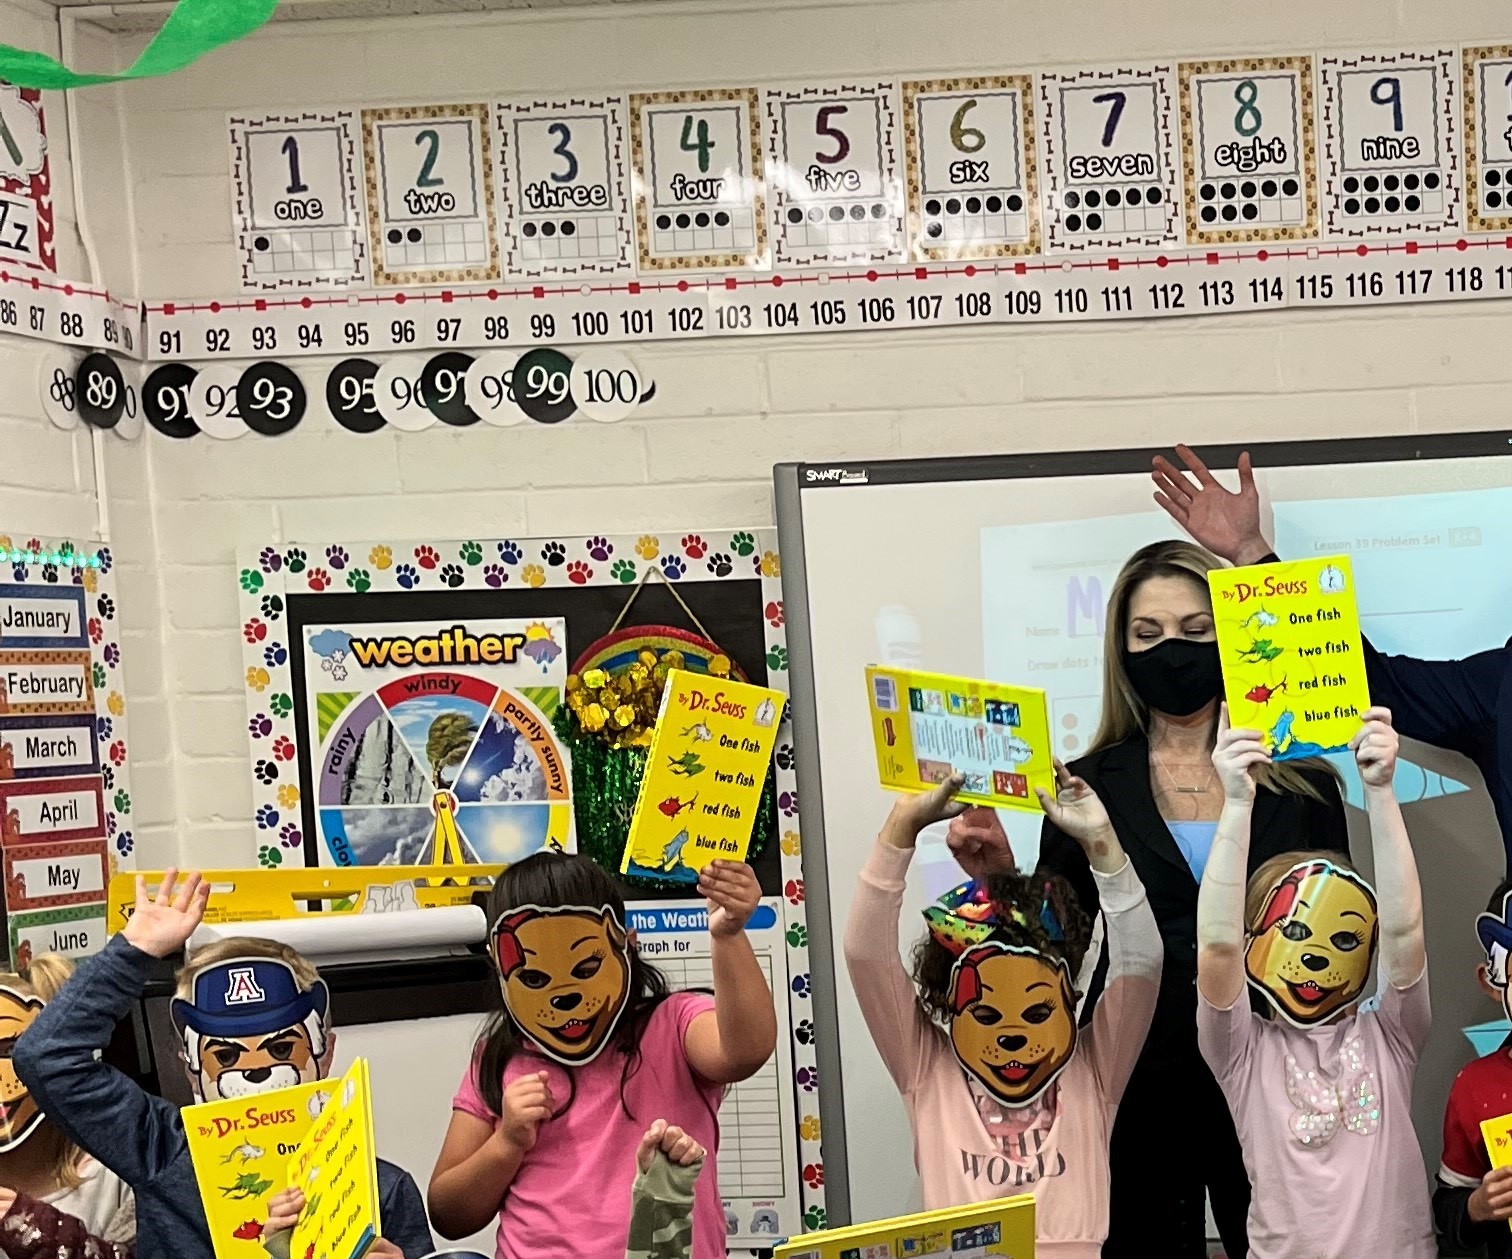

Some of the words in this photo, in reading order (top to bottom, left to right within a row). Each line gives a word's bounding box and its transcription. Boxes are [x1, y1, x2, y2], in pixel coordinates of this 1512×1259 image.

[1234, 79, 1263, 137] 8
[1369, 76, 1404, 133] 9
[950, 98, 985, 154] 6
[1092, 91, 1127, 147] 7
[679, 115, 715, 172] 4
[814, 105, 849, 164] 5
[1362, 135, 1419, 161] nine
[281, 136, 308, 194] 1
[415, 129, 443, 188] 2
[550, 122, 579, 182] 3
[1070, 152, 1153, 178] seven
[1215, 137, 1286, 172] eight
[805, 167, 860, 193] five
[950, 159, 989, 183] six
[525, 181, 607, 209] three
[671, 176, 725, 201] four
[275, 198, 323, 220] one
[405, 190, 455, 215] two
[30, 306, 45, 331] 87
[60, 312, 84, 338] 88
[159, 329, 181, 354] 91
[297, 323, 323, 349] 94
[436, 318, 462, 342] 97
[571, 311, 609, 337] 100
[715, 304, 752, 330] 103
[857, 297, 895, 323] 106
[1004, 290, 1042, 315] 109
[1148, 283, 1185, 310] 112
[1295, 274, 1334, 300] 115
[1444, 266, 1483, 293] 118
[86, 370, 117, 409] 89
[249, 376, 292, 420] 93
[525, 365, 571, 399] 99
[584, 368, 638, 404] 100
[806, 469, 842, 481] SMART
[1314, 540, 1351, 551] Lesson
[1372, 535, 1420, 547] Problem
[1423, 535, 1440, 545] Set
[3, 606, 71, 632] January
[352, 625, 526, 670] weather
[1028, 659, 1059, 670] Draw
[8, 672, 84, 697] February
[403, 676, 462, 694] windy
[26, 737, 77, 758] March
[328, 727, 355, 776] rainy
[503, 701, 544, 742] partly
[539, 746, 563, 794] sunny
[40, 800, 78, 824] April
[48, 866, 80, 888] May
[632, 913, 656, 929] the
[48, 932, 88, 952] June
[637, 941, 669, 955] Graph
[674, 941, 690, 951] for
[225, 968, 265, 1004] A
